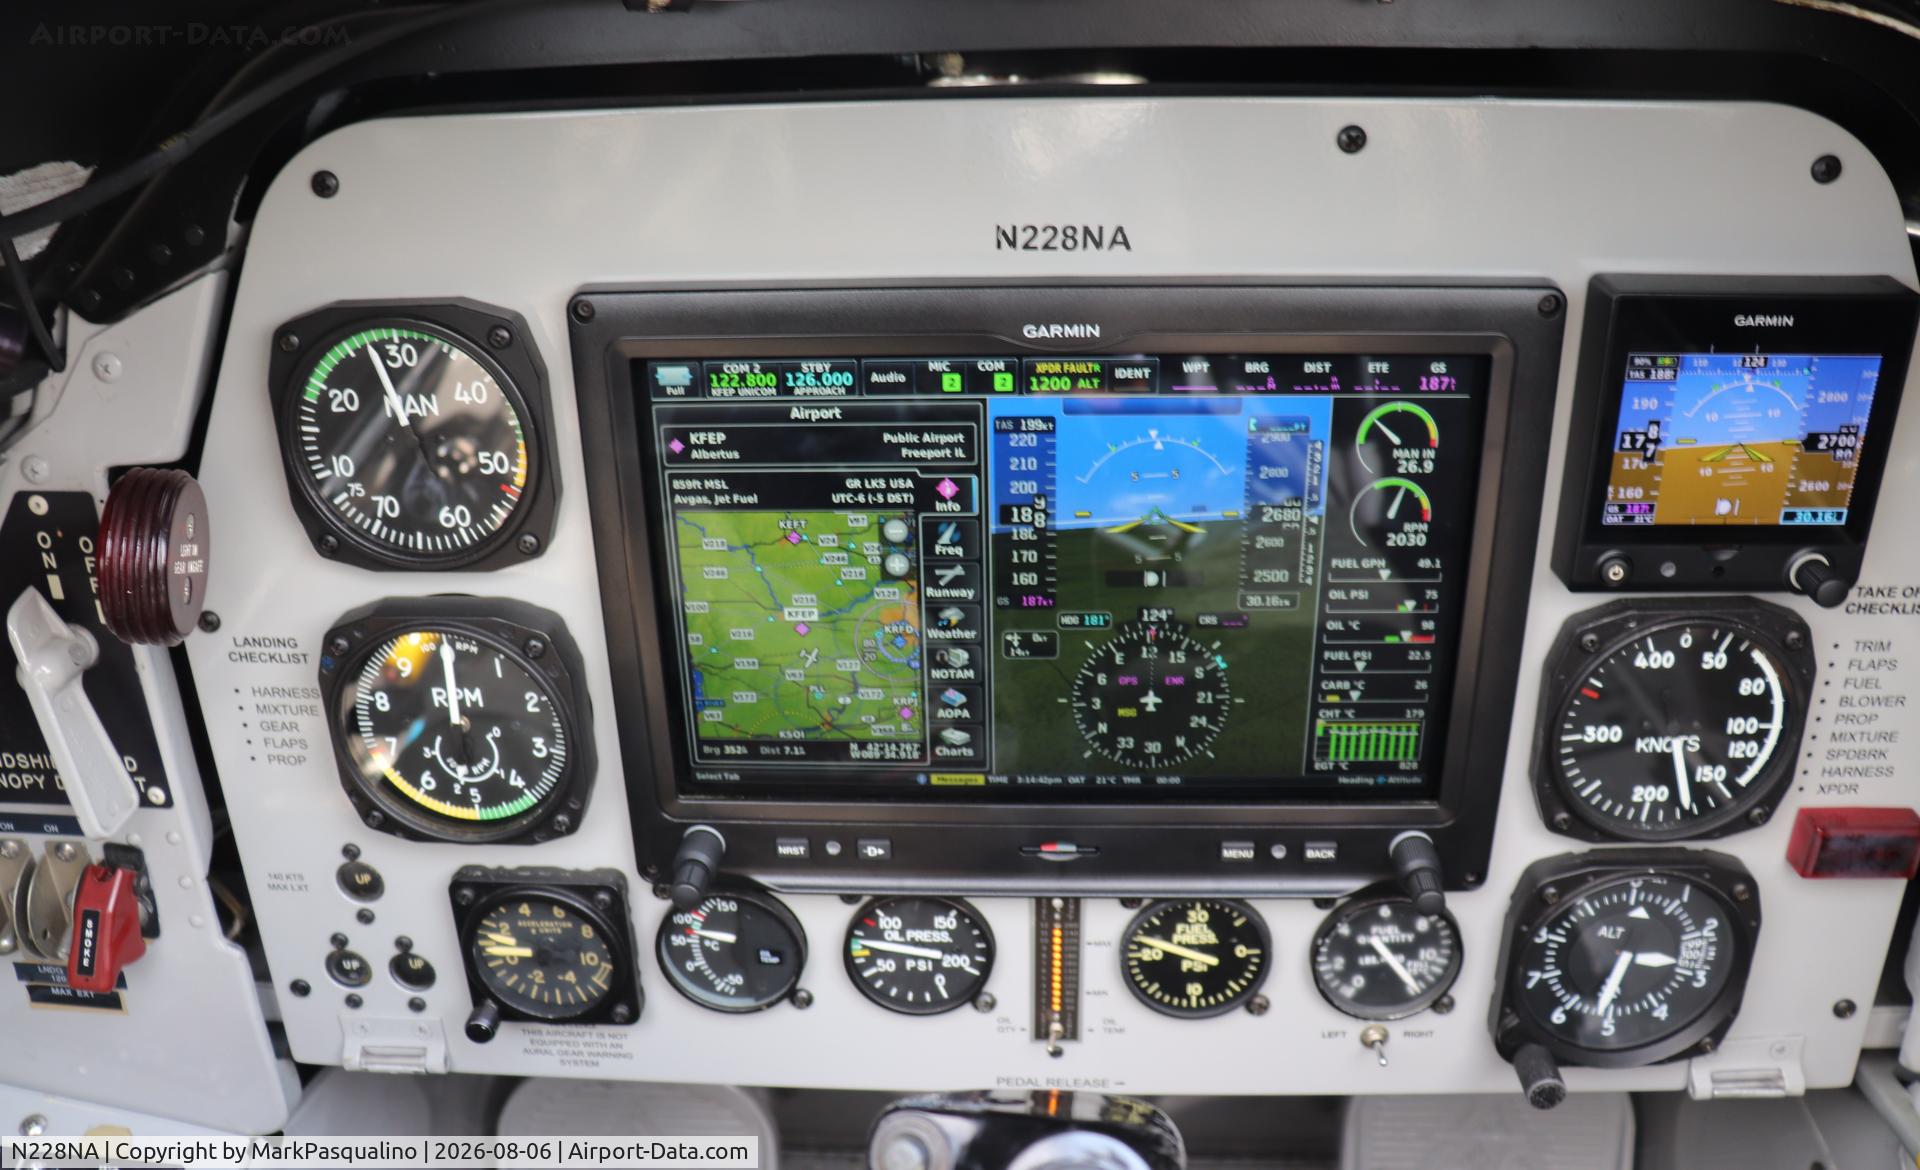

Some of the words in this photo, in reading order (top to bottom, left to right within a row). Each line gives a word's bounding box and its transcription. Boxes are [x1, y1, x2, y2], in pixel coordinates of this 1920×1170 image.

[996, 225, 1132, 250] N228NA
[1734, 315, 1794, 327] GARMIN
[1023, 323, 1100, 338] GARMIN
[385, 343, 418, 368] 30
[723, 364, 751, 374] COM
[800, 362, 832, 373] STBY
[928, 362, 951, 372] MIC
[976, 360, 1006, 372] COM
[1182, 361, 1210, 373] WPT
[1245, 362, 1270, 373] BRG
[1304, 362, 1332, 373] DIST
[1368, 362, 1390, 373] ETE
[1430, 362, 1447, 373] GS
[785, 372, 854, 387] 126.000
[870, 371, 906, 384] Audio
[1114, 368, 1152, 379] IDENT
[709, 373, 778, 388] 122.800
[1030, 376, 1072, 391] 1200
[1078, 378, 1100, 389] ALT
[454, 381, 487, 405] 40
[711, 388, 736, 397] KFEP
[738, 388, 777, 397] UNICOM
[793, 387, 846, 396] APPROACH
[329, 388, 359, 412] 20
[790, 406, 842, 422] Airport
[689, 431, 727, 445] KFEP
[882, 432, 918, 444] Public
[922, 432, 965, 446] Airport
[1009, 434, 1037, 448] 220
[690, 450, 740, 460] Albertus
[901, 447, 952, 460] Freeport
[1392, 449, 1419, 459] MAN
[1422, 449, 1435, 459] IN
[331, 455, 354, 477] 10
[478, 452, 509, 475] 50
[1009, 457, 1037, 471] 210
[1397, 459, 1434, 473] 26.9
[347, 483, 365, 497] 75
[704, 479, 729, 490] MSL
[864, 479, 887, 489] LKS
[889, 479, 914, 489] USA
[1010, 480, 1037, 495] 200
[733, 493, 758, 504] Fuel
[887, 493, 914, 505] DST)
[371, 496, 400, 518] 70
[935, 501, 961, 512] Info
[439, 505, 471, 528] 60
[1261, 507, 1301, 523] 2680
[1403, 522, 1428, 533] RPM
[1386, 533, 1426, 546] 2030
[36, 531, 57, 569] ON
[935, 544, 964, 557] Freq
[1012, 550, 1038, 563] 170
[1331, 558, 1359, 568] FUEL
[1012, 572, 1038, 586] 160
[1253, 569, 1289, 583] 2500
[926, 587, 975, 600] Runway
[1328, 589, 1349, 600] OIL
[1350, 590, 1368, 600] PSI
[1856, 586, 1897, 598] TAKE
[1142, 609, 1173, 622] 124°
[1198, 616, 1218, 625] CRS
[1326, 620, 1345, 630] OIL
[927, 628, 977, 640] Weather
[232, 636, 298, 648] LANDING
[1854, 640, 1893, 652] TRIM
[228, 651, 309, 664] CHECKLIST
[1168, 652, 1186, 663] 15
[1323, 651, 1351, 661] FUEL
[1353, 651, 1372, 661] PSI
[1633, 650, 1675, 669] 400
[1701, 651, 1727, 670] 50
[397, 658, 412, 678] 9
[1848, 659, 1899, 672] FLAPS
[931, 669, 975, 679] NOTAM
[1165, 676, 1185, 685] ENR
[1738, 678, 1765, 695] 80
[1843, 678, 1883, 689] FUEL
[251, 687, 320, 699] HARNESS
[1196, 692, 1212, 703] 21
[374, 691, 390, 712] 8
[1839, 696, 1906, 708] BLOWER
[255, 704, 319, 716] MIXTURE
[937, 709, 970, 719] AOPA
[1190, 716, 1207, 727] 24
[1834, 713, 1879, 725] PROP
[260, 720, 300, 732] GEAR
[1726, 717, 1758, 734] 100
[1582, 725, 1623, 743] 300
[1829, 732, 1899, 743] MIXTURE
[263, 738, 308, 750] FLAPS
[532, 737, 547, 758] 3
[1116, 737, 1134, 749] 33
[1144, 742, 1162, 753] 30
[935, 746, 974, 757] Charts
[1728, 741, 1759, 758] 120
[1825, 749, 1890, 761] SPDBRK
[267, 754, 307, 766] PROP
[1695, 765, 1726, 782] 150
[1821, 767, 1895, 778] HARNESS
[1631, 785, 1669, 803] 200
[1817, 783, 1859, 795] XPDR
[778, 846, 805, 855] NRST
[1223, 849, 1254, 859] MENU
[1306, 849, 1336, 859] BACK
[355, 873, 372, 885] UP
[672, 914, 692, 924] 100
[934, 916, 957, 929] 150
[1187, 910, 1209, 923] 30
[879, 917, 902, 929] 100
[884, 930, 905, 941] OIL
[1598, 926, 1626, 939] ALT
[82, 918, 93, 968] SMOKE
[342, 959, 360, 970] UP
[408, 958, 424, 969] UP
[580, 952, 599, 966] 10
[942, 955, 970, 967] 200
[876, 959, 896, 972] 50
[545, 1029, 593, 1039] AIRCRAFT
[607, 1032, 628, 1040] NOT
[1322, 1031, 1346, 1039] LEFT
[587, 1050, 634, 1060] WARNING
[559, 1058, 600, 1068] SYSTEM
[996, 1077, 1042, 1087] PEDAL
[1046, 1077, 1110, 1088] RELEASE
